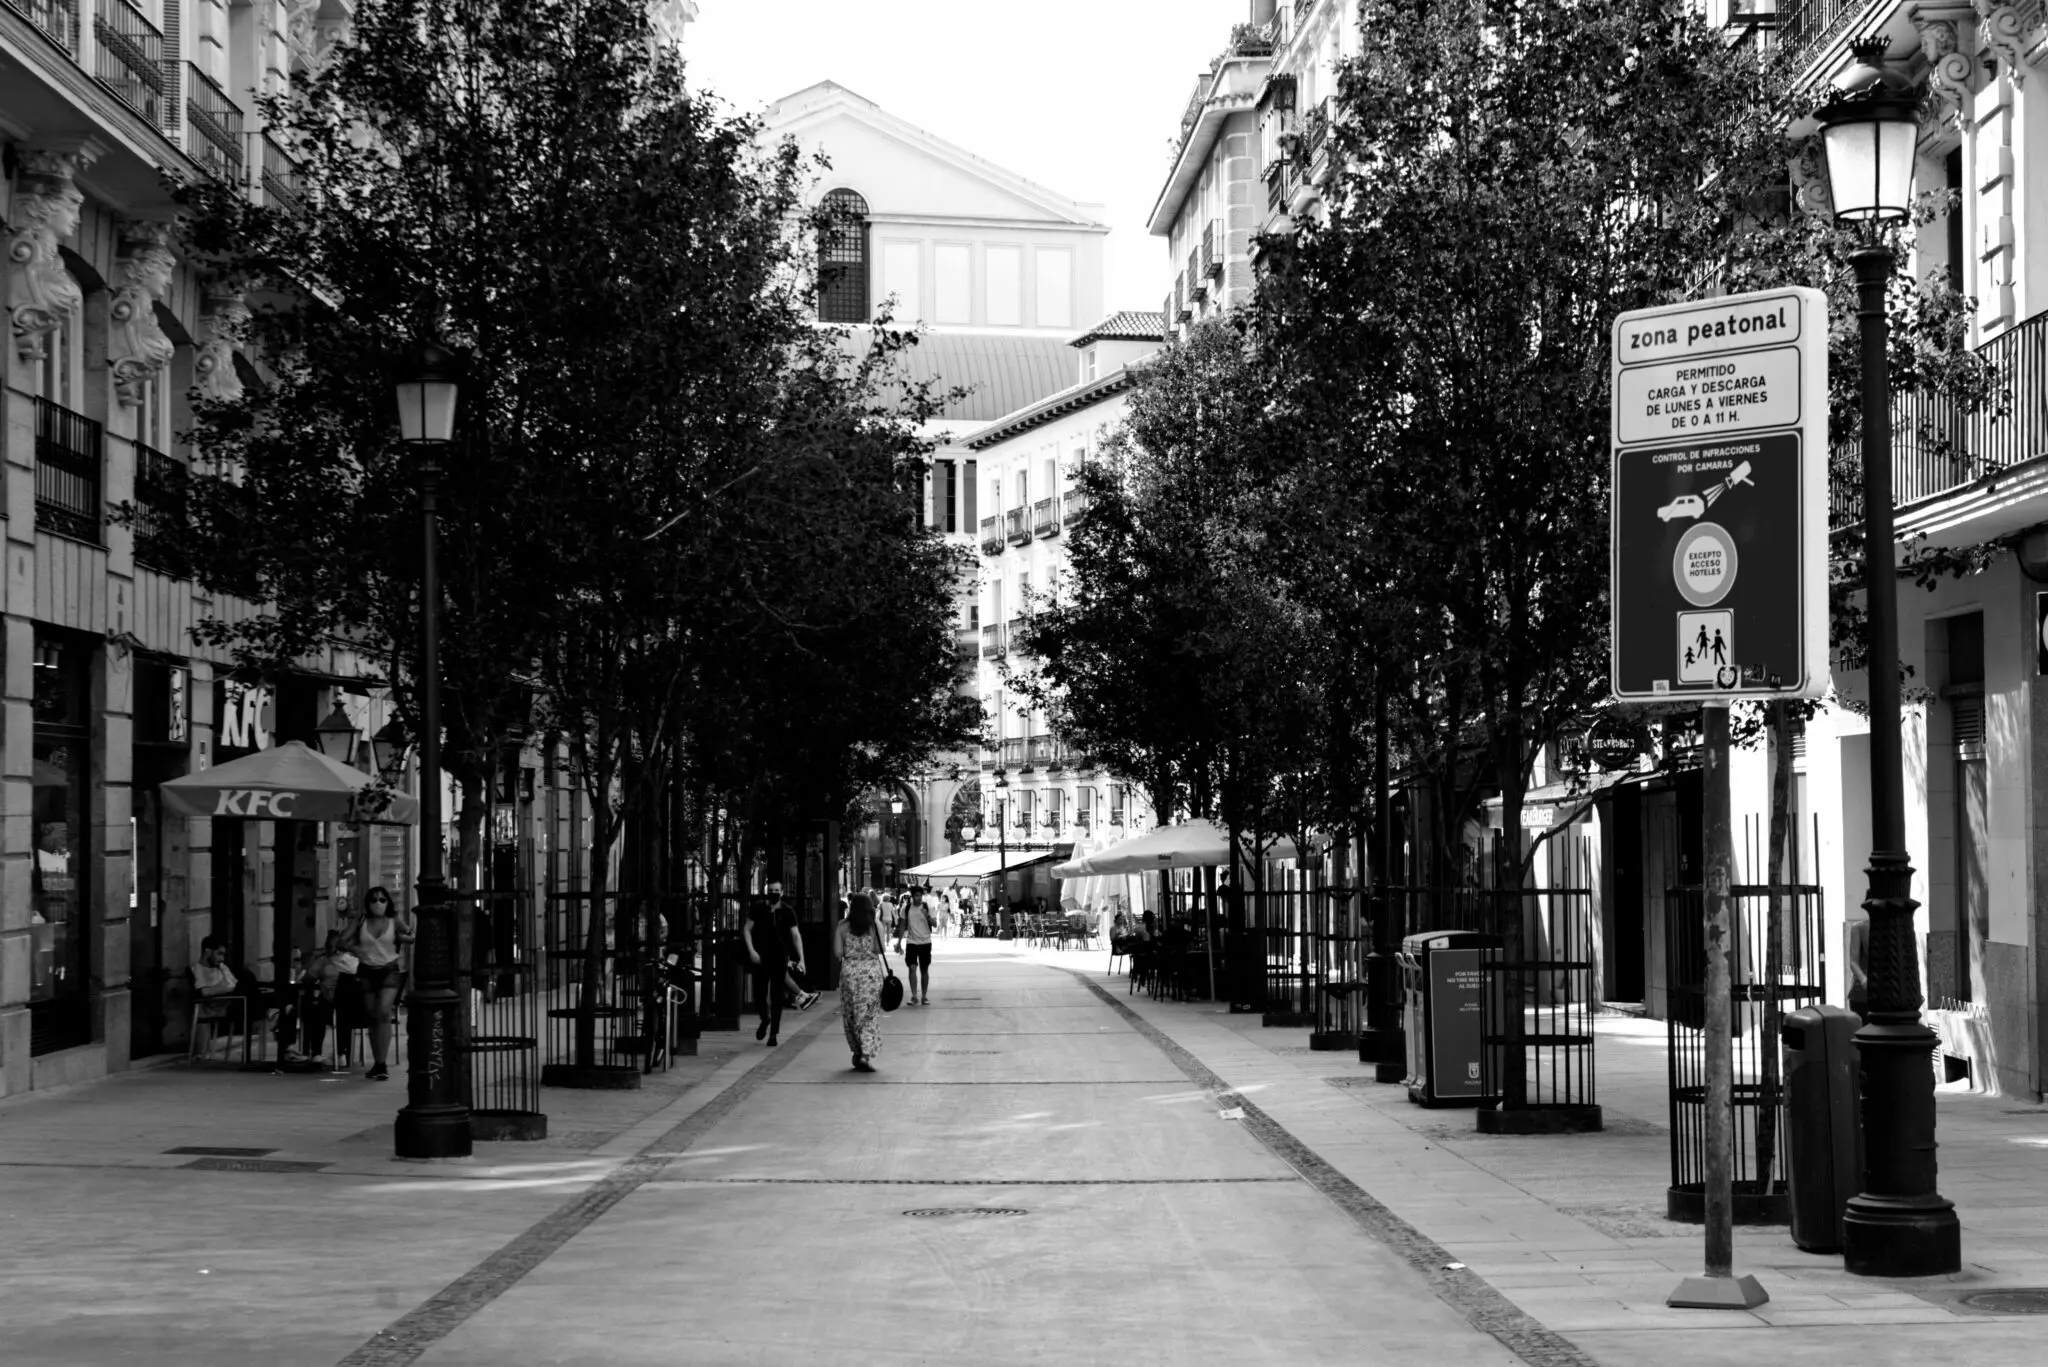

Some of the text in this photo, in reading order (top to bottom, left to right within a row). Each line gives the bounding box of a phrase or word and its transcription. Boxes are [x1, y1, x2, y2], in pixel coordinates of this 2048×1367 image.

[1631, 307, 1786, 349] zona peatonal
[1676, 363, 1736, 382] PERMITIDO
[1648, 375, 1766, 401] CARGA Y DESCARGA
[1646, 391, 1768, 416] DE LUNES A VIERNES
[1671, 417, 1686, 429] DE
[1703, 413, 1711, 424] A
[1716, 412, 1724, 423] 11
[1729, 410, 1740, 422] H.
[1652, 444, 1760, 464] CONTROL DE INFRACCIONES
[1677, 460, 1733, 473] POR CAMARAS
[1689, 551, 1721, 560] EXCEPTO
[1691, 560, 1720, 568] ACCESO
[1690, 568, 1721, 576] HOTELES
[221, 679, 272, 750] KFC
[213, 789, 296, 817] KFC
